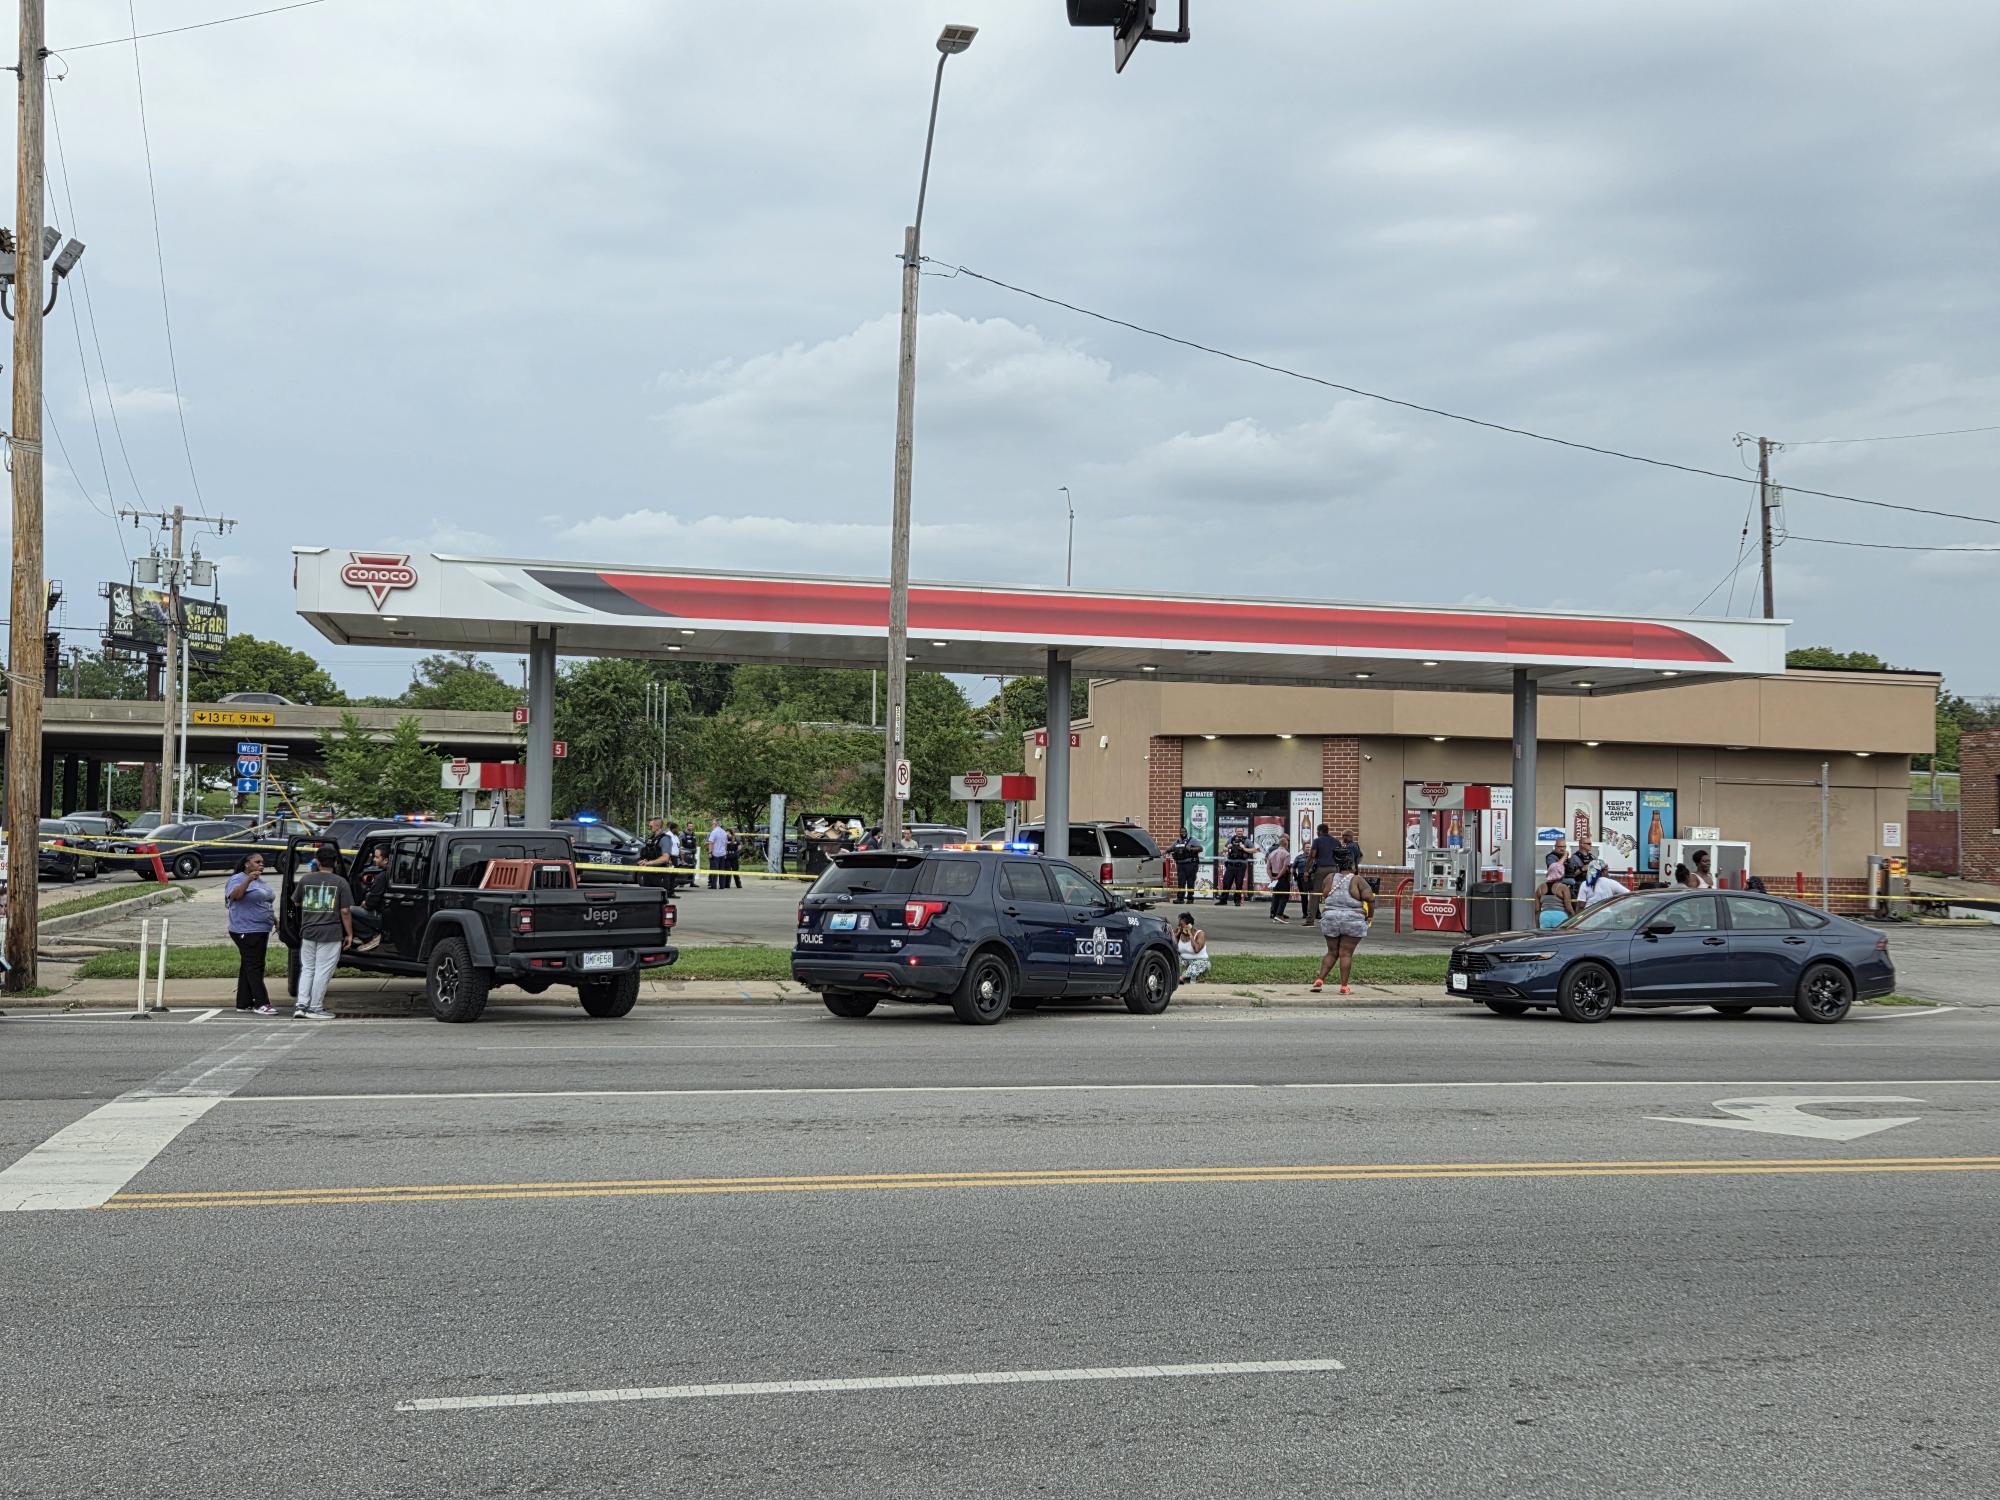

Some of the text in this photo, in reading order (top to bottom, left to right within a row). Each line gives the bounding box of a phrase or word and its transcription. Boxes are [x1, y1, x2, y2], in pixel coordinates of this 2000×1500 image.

[208, 713, 220, 722] 13
[240, 714, 247, 723] 9
[516, 710, 523, 720] 6
[1072, 736, 1077, 745] 3
[241, 745, 259, 753] WEST
[555, 745, 562, 755] 5
[240, 761, 258, 773] 70
[583, 908, 618, 923] Jeep
[801, 933, 824, 945] POLICE
[1077, 941, 1122, 955] KC PD
